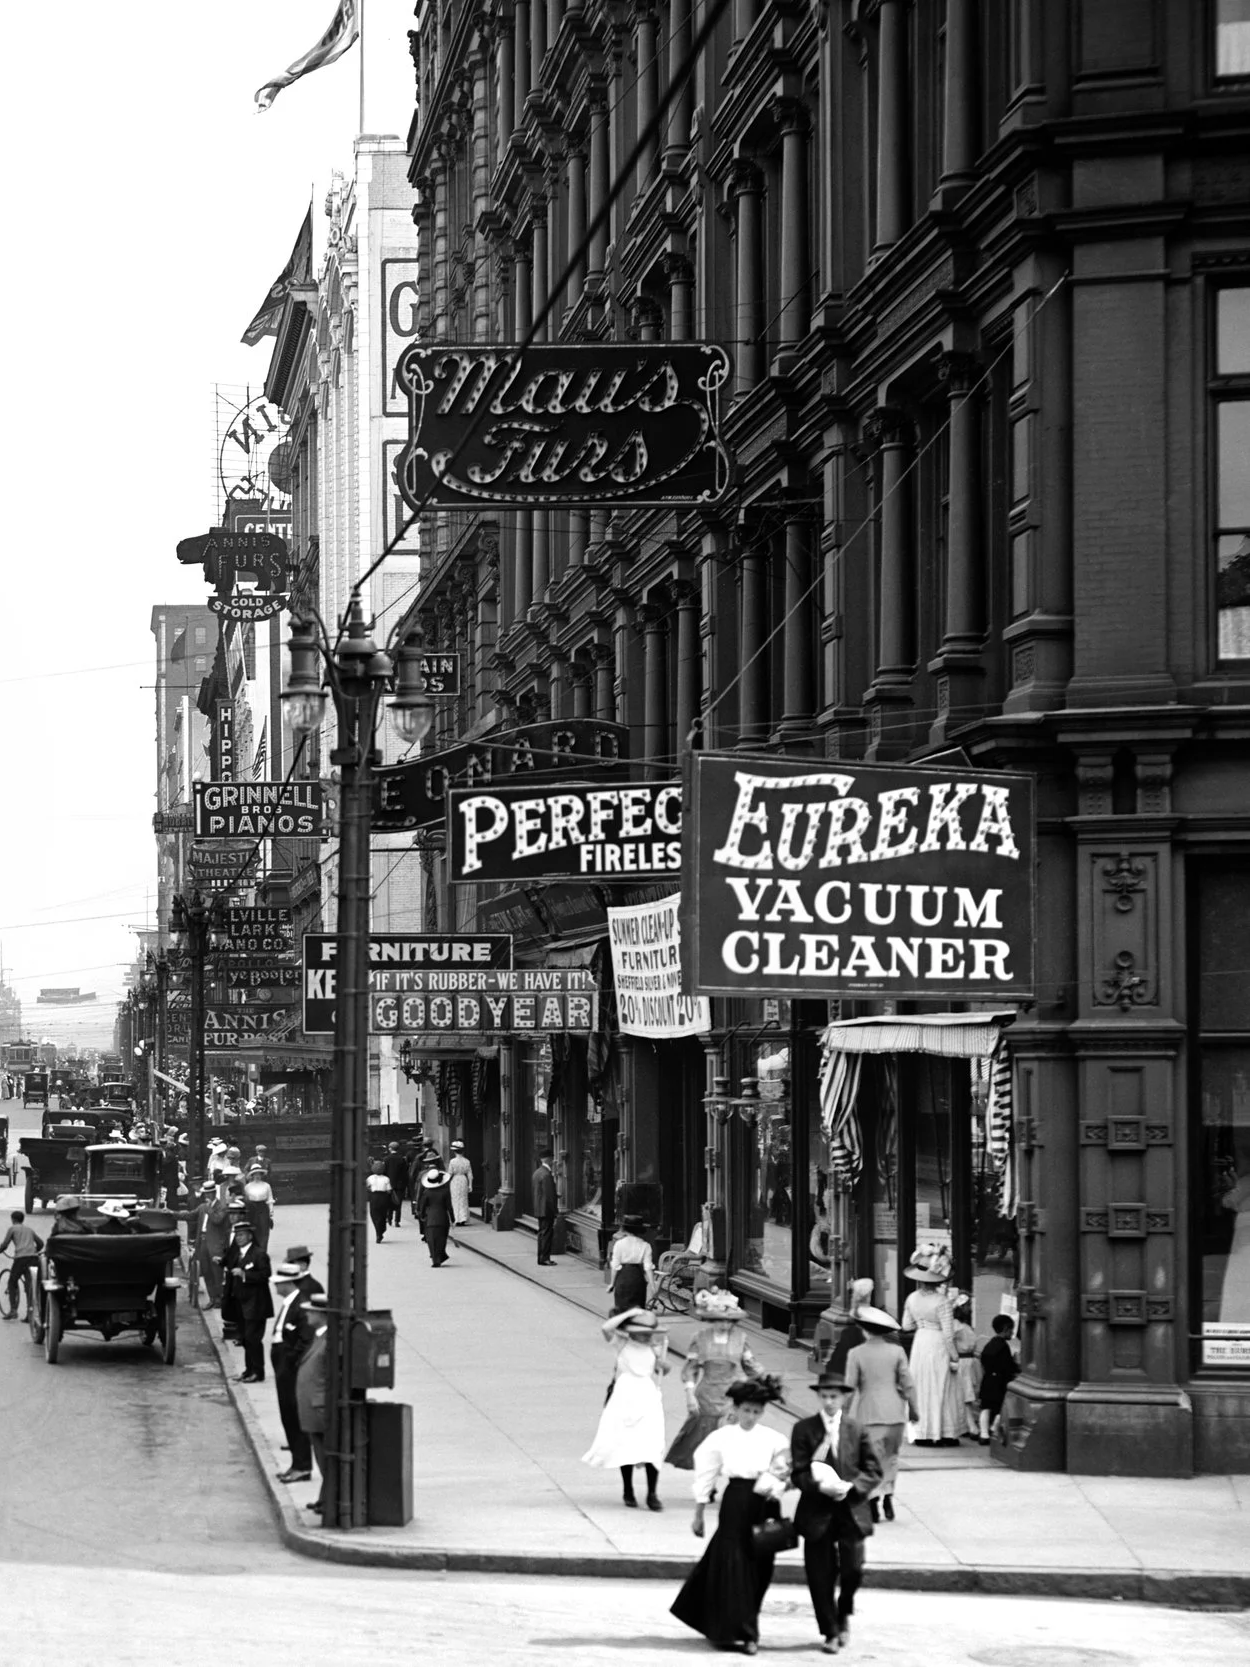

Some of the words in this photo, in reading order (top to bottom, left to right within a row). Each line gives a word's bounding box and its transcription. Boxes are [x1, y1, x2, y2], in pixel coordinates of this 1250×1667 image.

[467, 420, 649, 483] Furs
[203, 535, 271, 556] ANNIS
[218, 553, 281, 579] FURS
[213, 601, 281, 618] STORAGE
[231, 597, 263, 607] COLD
[204, 786, 319, 810] GRINNELL
[241, 805, 282, 814] BROS
[210, 815, 313, 834] PIANOS
[713, 771, 1021, 871] EUREKA
[725, 877, 1003, 929] VACUUM
[321, 942, 492, 961] FRNITURE
[721, 929, 1013, 982] CLEANER
[376, 972, 390, 991] IF
[393, 971, 423, 990] IT'S
[524, 972, 562, 990] HAVE
[567, 972, 587, 990] IT!
[204, 1009, 286, 1029] ANNIS
[375, 997, 591, 1029] GOODYEAR
[204, 1032, 239, 1046] FUR
